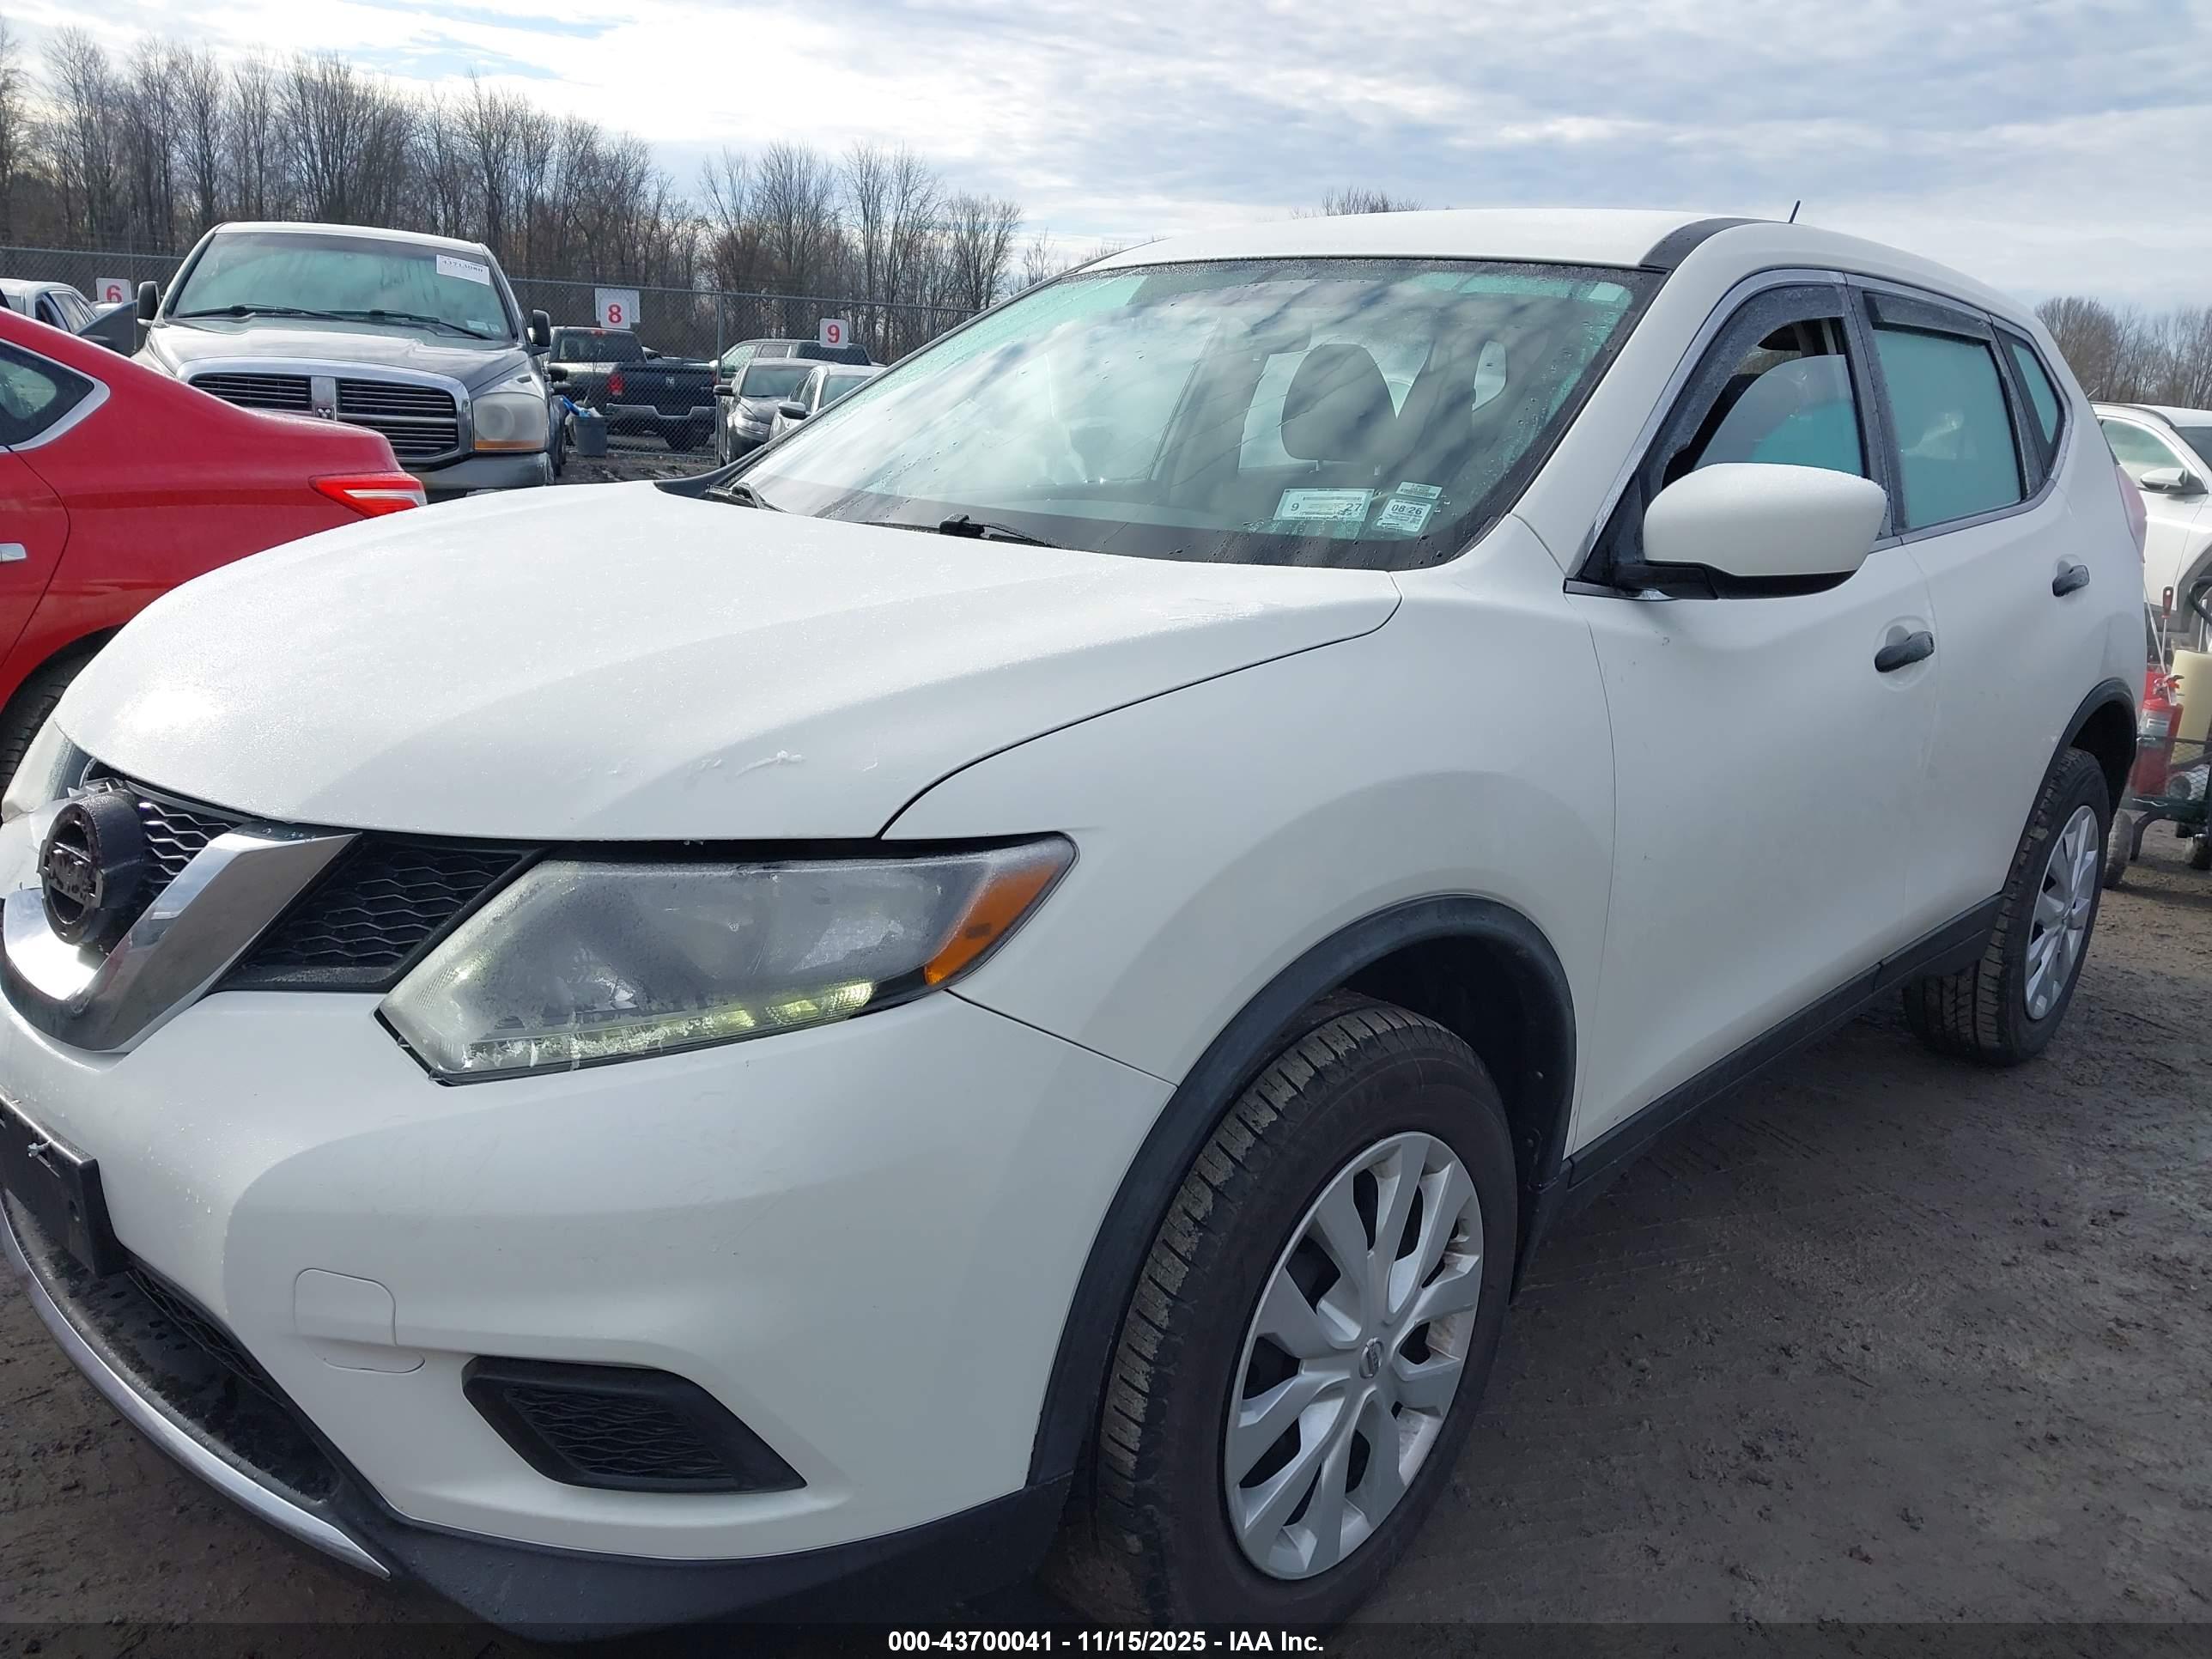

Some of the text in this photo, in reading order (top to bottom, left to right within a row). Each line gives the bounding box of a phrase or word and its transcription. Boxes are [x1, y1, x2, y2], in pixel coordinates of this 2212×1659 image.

[106, 284, 123, 303] 6
[608, 304, 622, 324] 8
[827, 324, 840, 343] 9
[1291, 502, 1300, 512] 9
[1391, 504, 1406, 513] 08
[1408, 507, 1423, 515] 26
